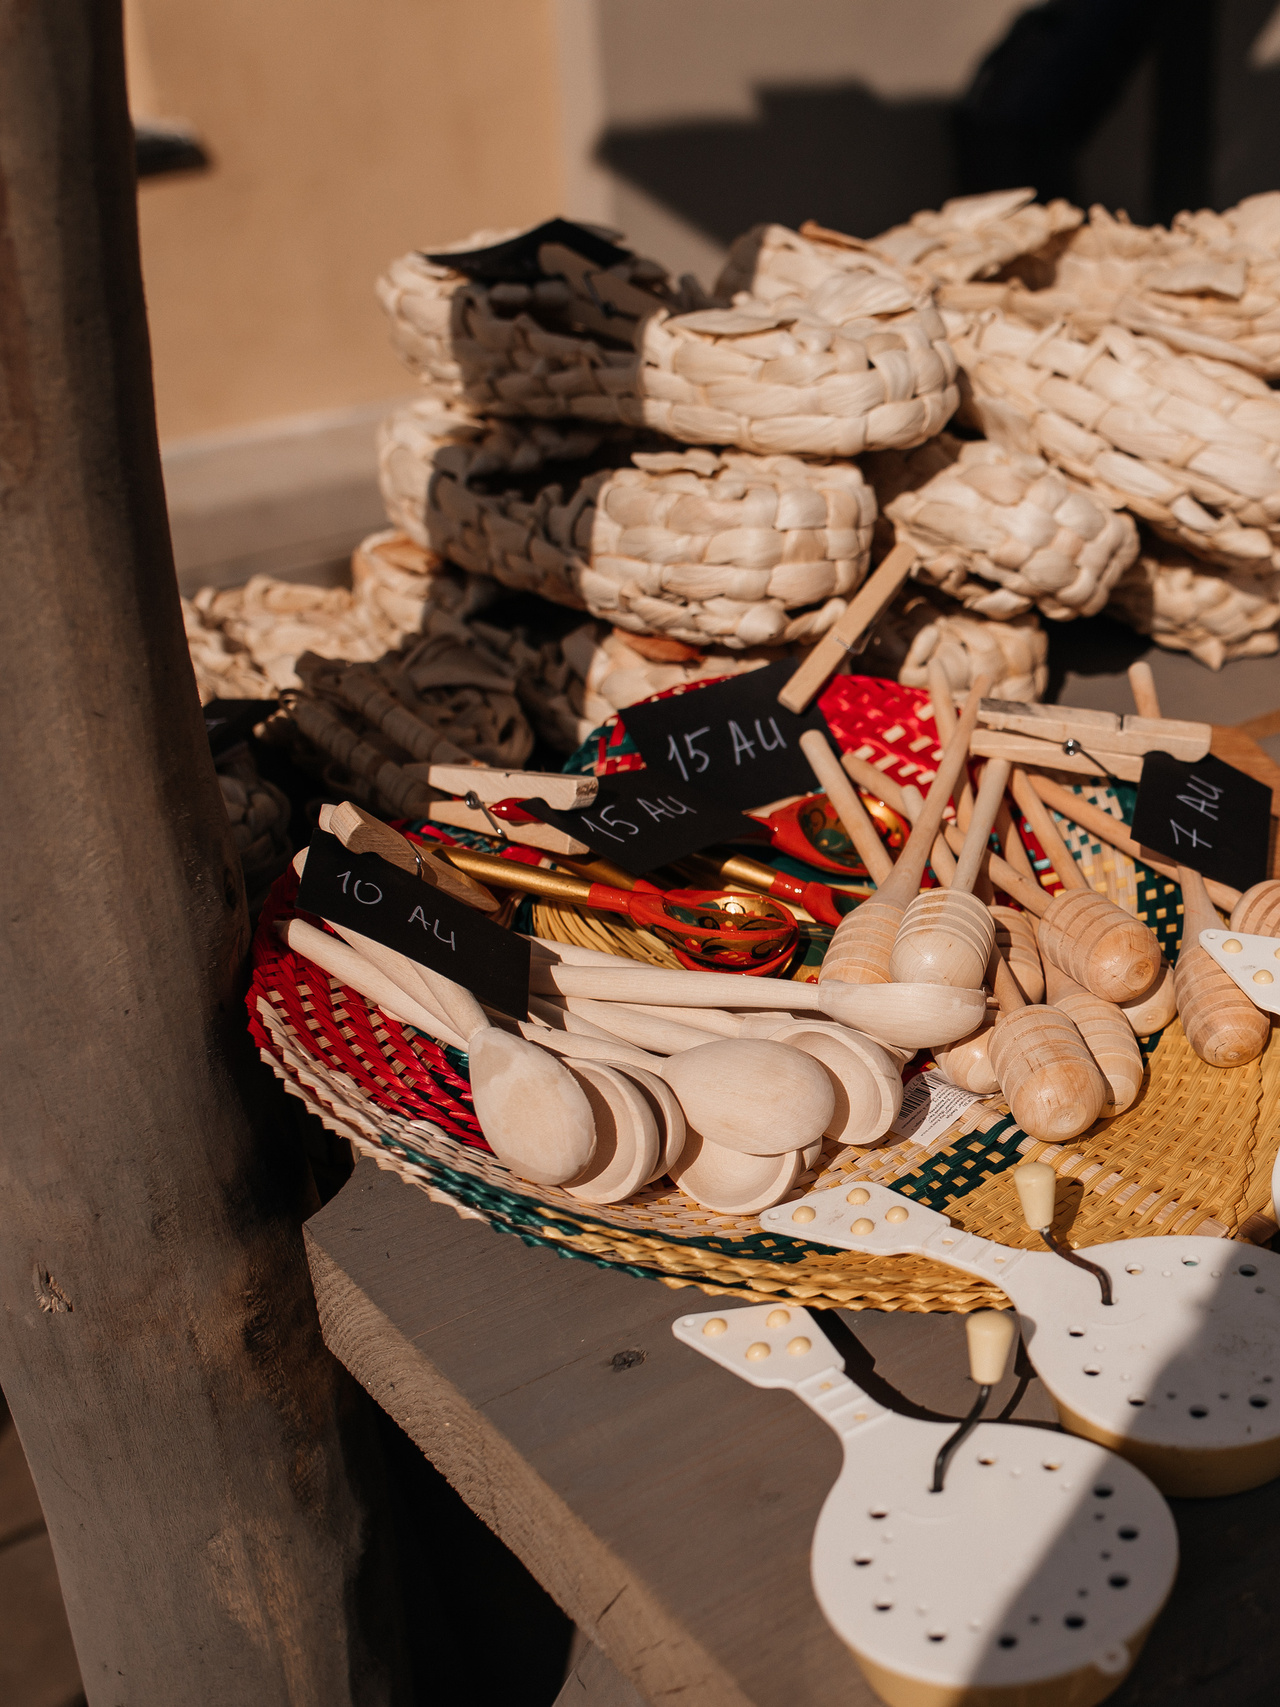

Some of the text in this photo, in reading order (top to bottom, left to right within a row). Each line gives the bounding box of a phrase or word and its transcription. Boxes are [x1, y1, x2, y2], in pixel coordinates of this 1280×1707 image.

[667, 726, 710, 782] 15
[581, 804, 639, 843] 15
[1170, 818, 1213, 849] 7
[336, 870, 383, 905] 10
